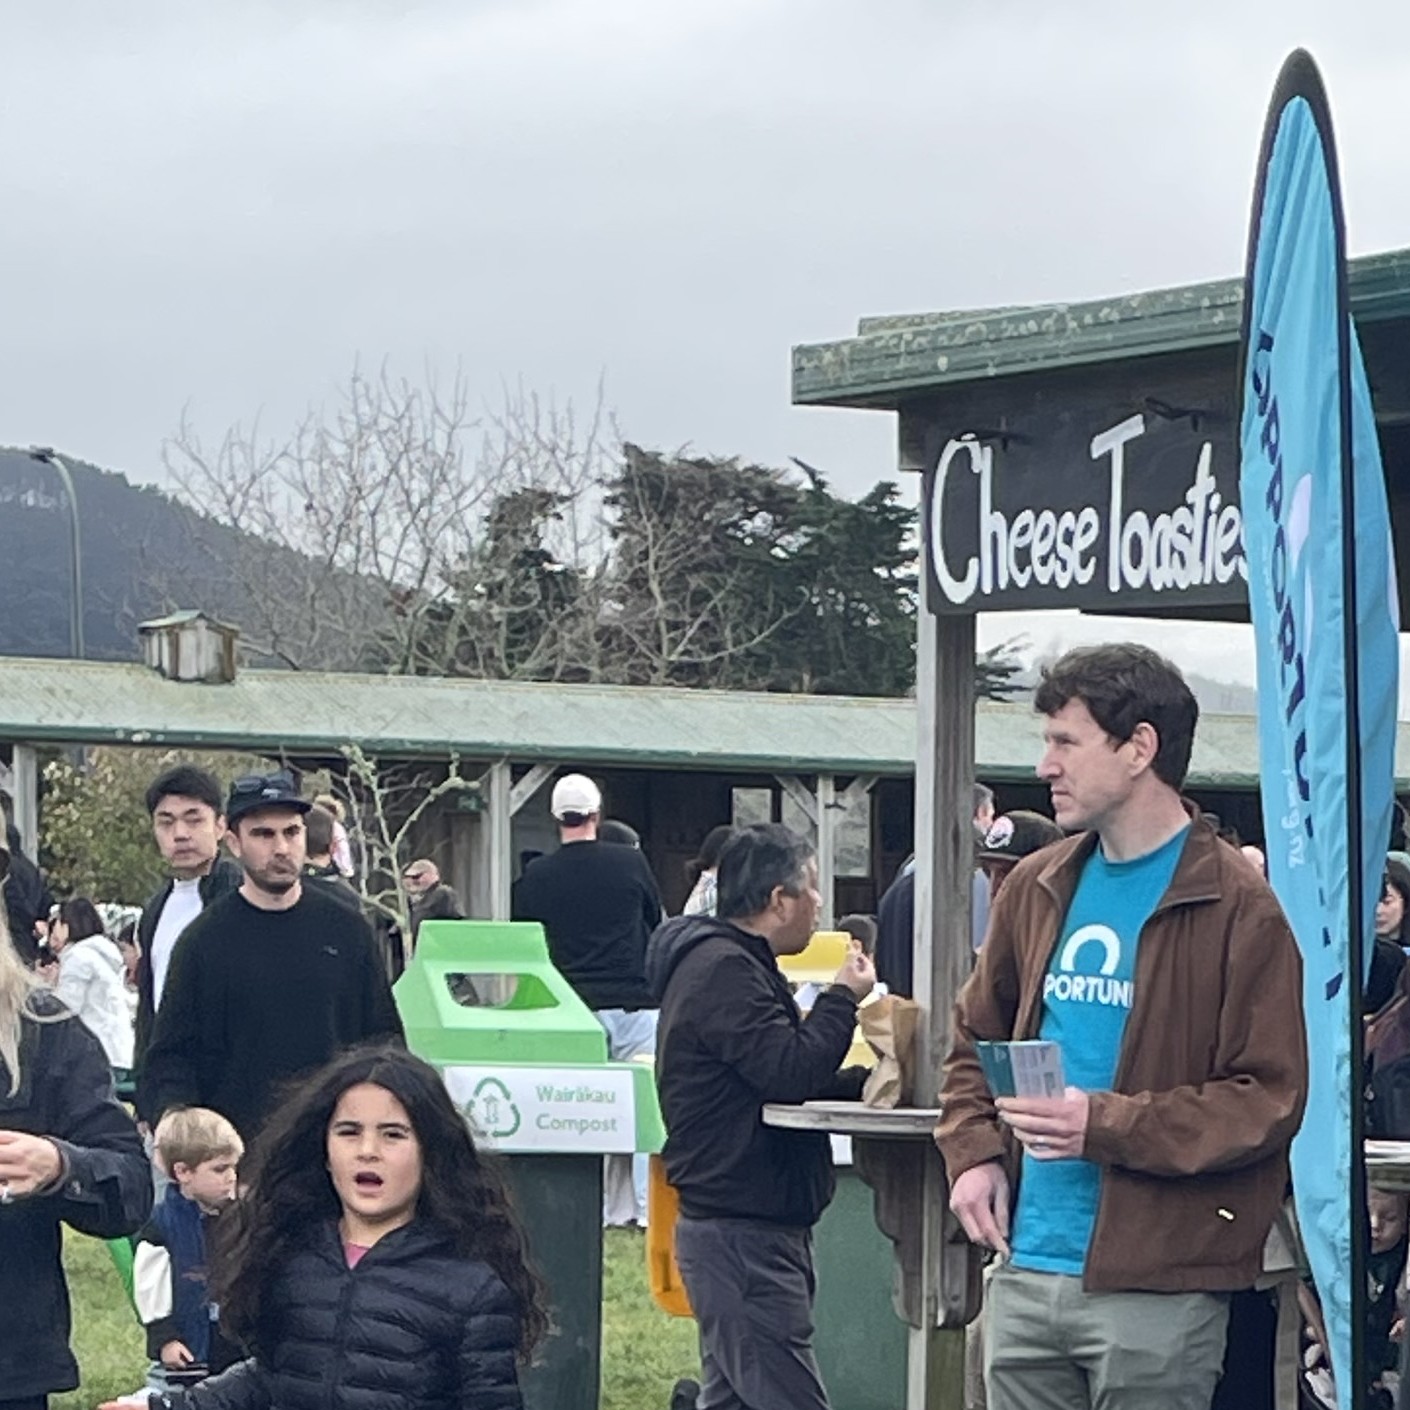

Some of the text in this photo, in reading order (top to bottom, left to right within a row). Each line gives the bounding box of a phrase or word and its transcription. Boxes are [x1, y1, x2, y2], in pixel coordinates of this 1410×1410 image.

[932, 433, 1098, 603] Cheese
[1043, 973, 1134, 1009] PORTUNI
[535, 1113, 618, 1135] Compost
